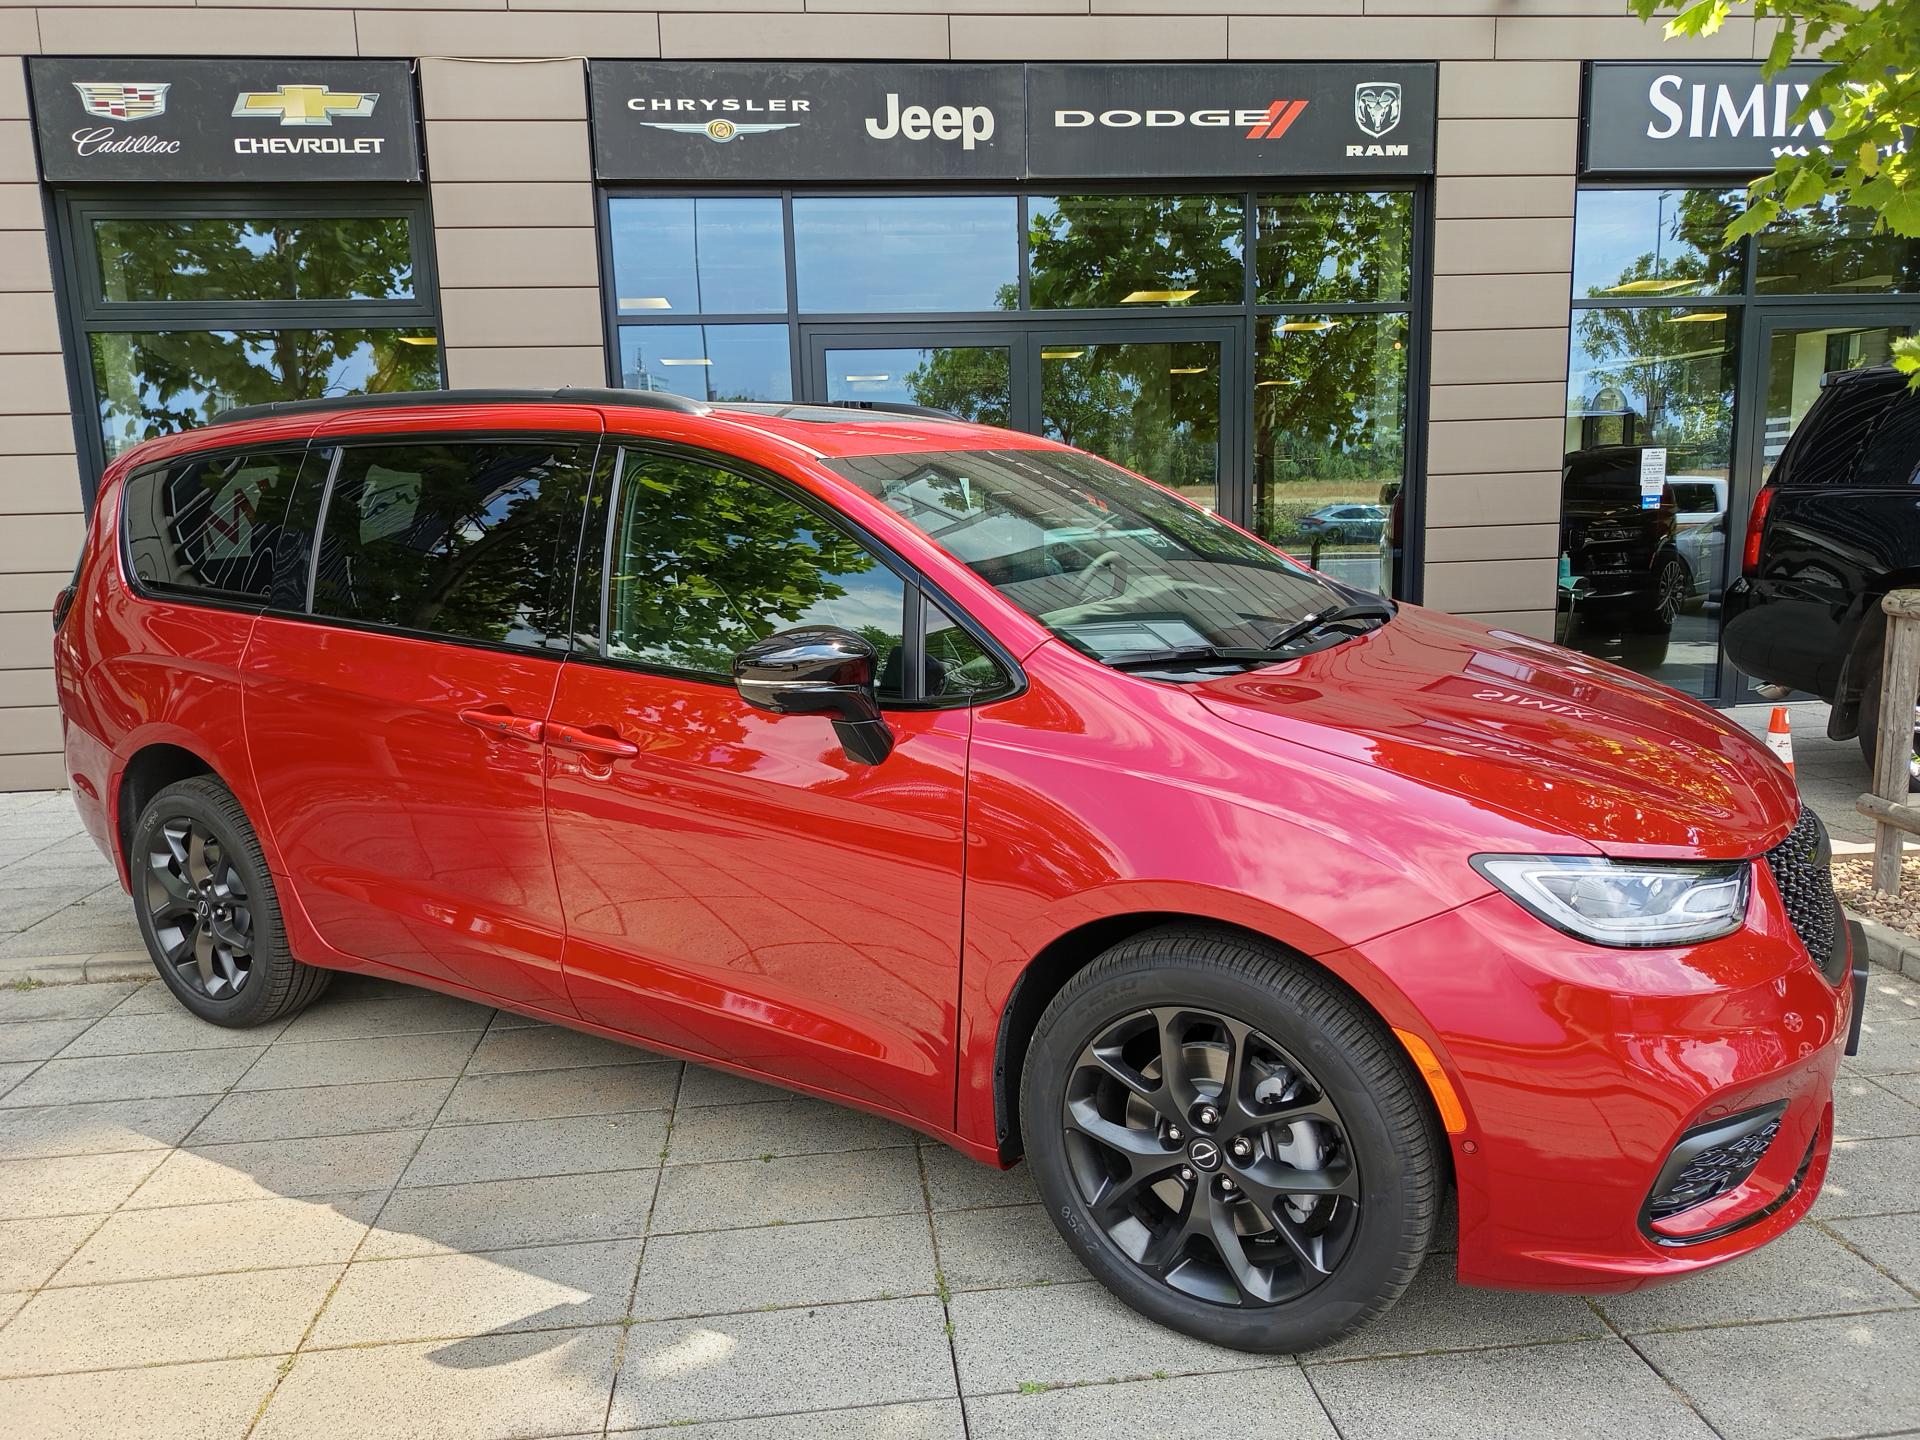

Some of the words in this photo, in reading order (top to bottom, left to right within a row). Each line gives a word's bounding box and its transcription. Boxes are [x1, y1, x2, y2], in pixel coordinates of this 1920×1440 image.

[628, 97, 811, 112] CHRYSLER
[865, 93, 995, 150] Jeep
[1055, 109, 1272, 128] DODGE
[72, 127, 181, 157] Cadillac
[234, 137, 385, 154] CHEVROLET
[1346, 144, 1409, 157] RAM
